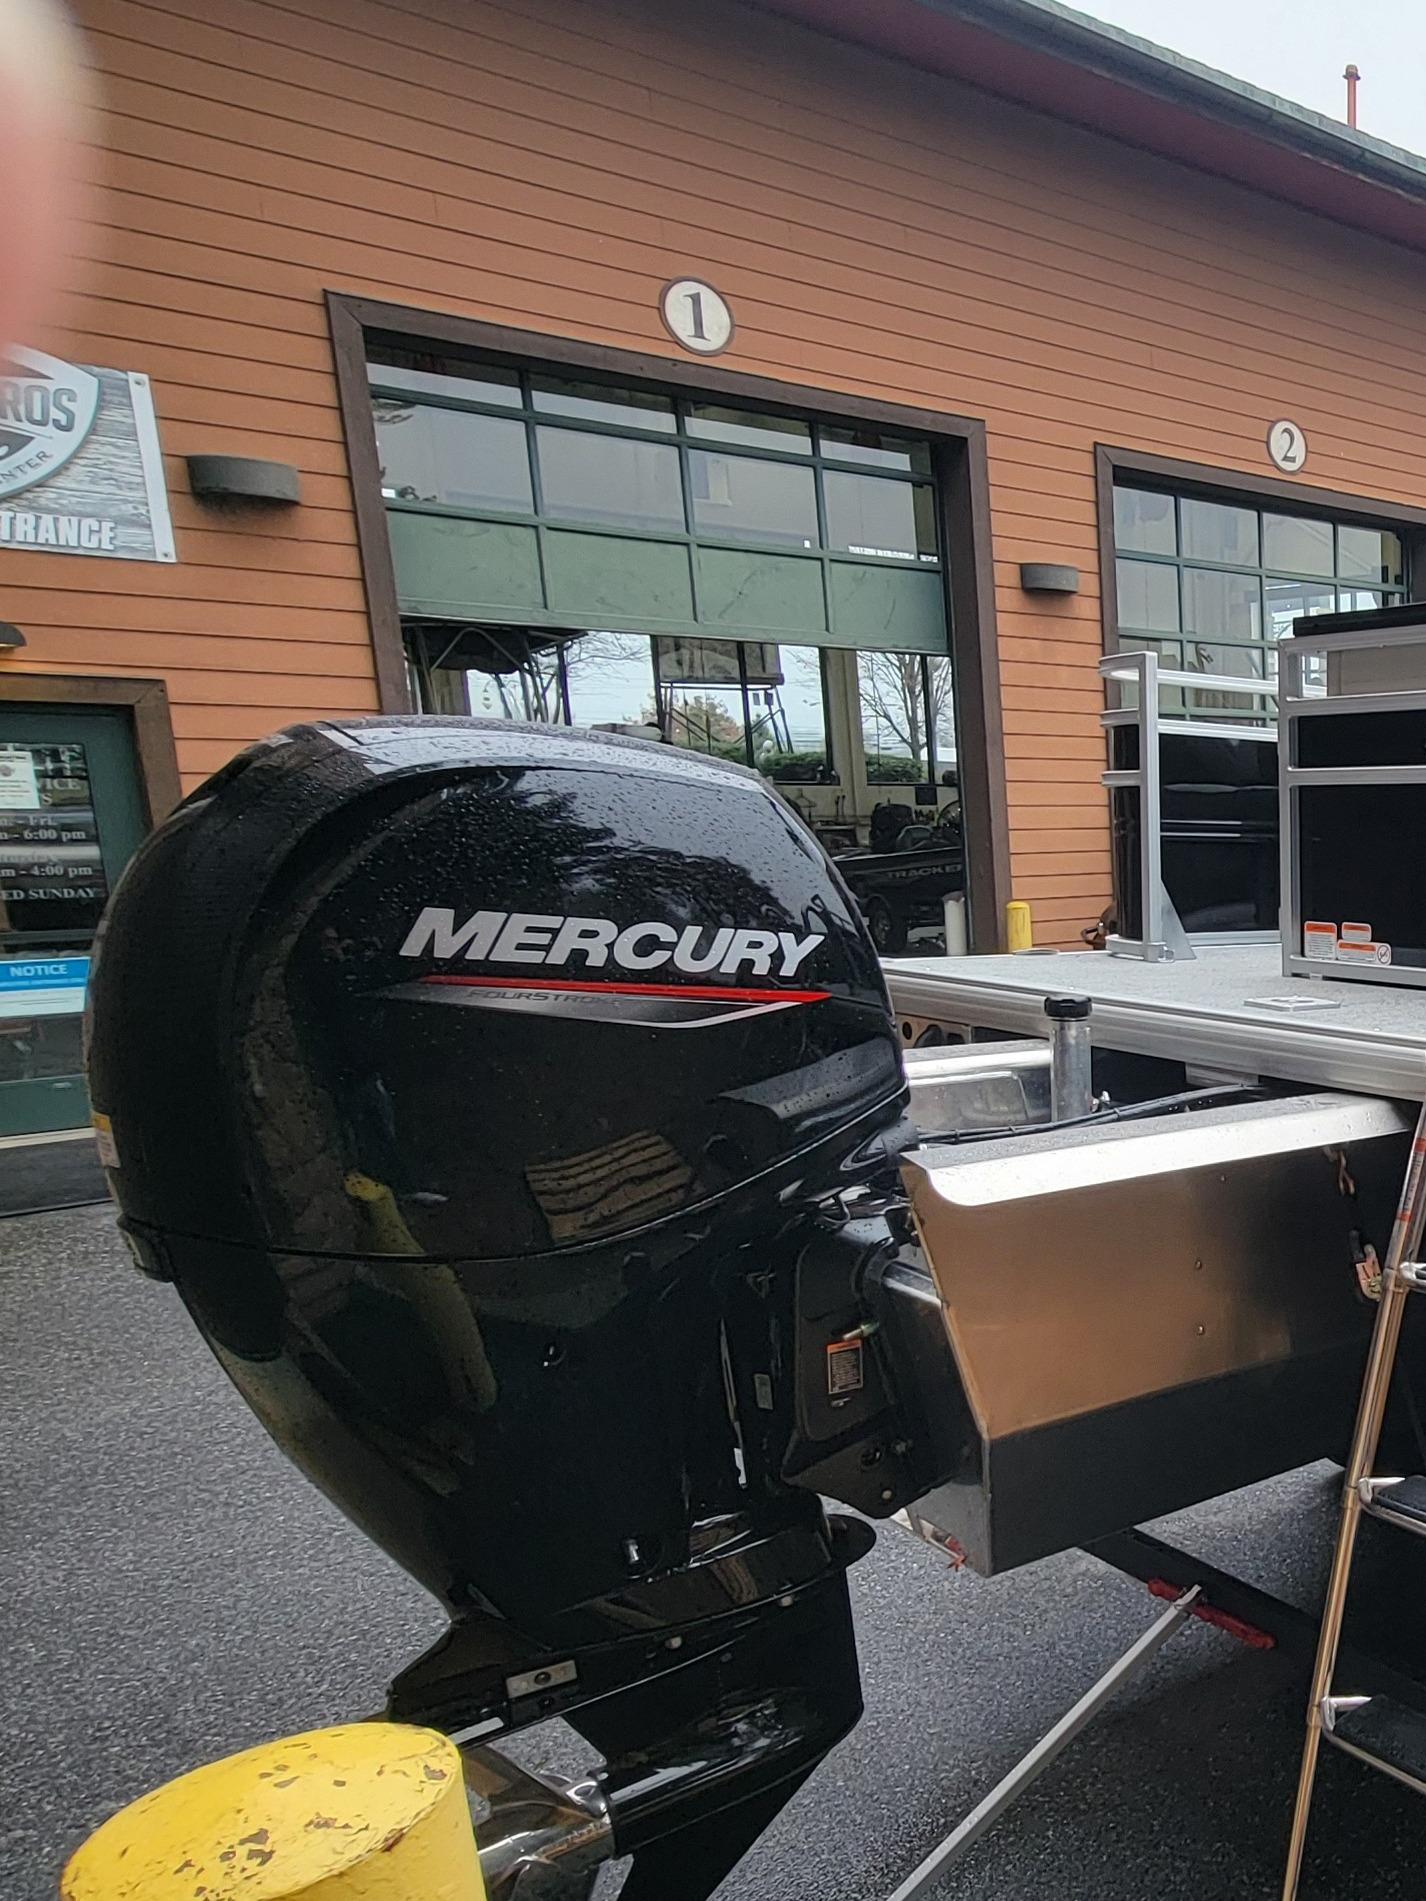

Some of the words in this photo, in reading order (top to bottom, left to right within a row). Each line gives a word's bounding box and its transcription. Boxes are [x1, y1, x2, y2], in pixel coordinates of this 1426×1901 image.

[682, 291, 711, 342] 1
[1281, 427, 1297, 464] 2
[23, 829, 58, 840] 6:00
[61, 831, 87, 842] pm
[30, 864, 64, 876] 4:00
[67, 866, 93, 879] pm
[28, 887, 97, 900] SUNDAY
[399, 906, 826, 978] MERCURY
[8, 963, 69, 978] NOTICE
